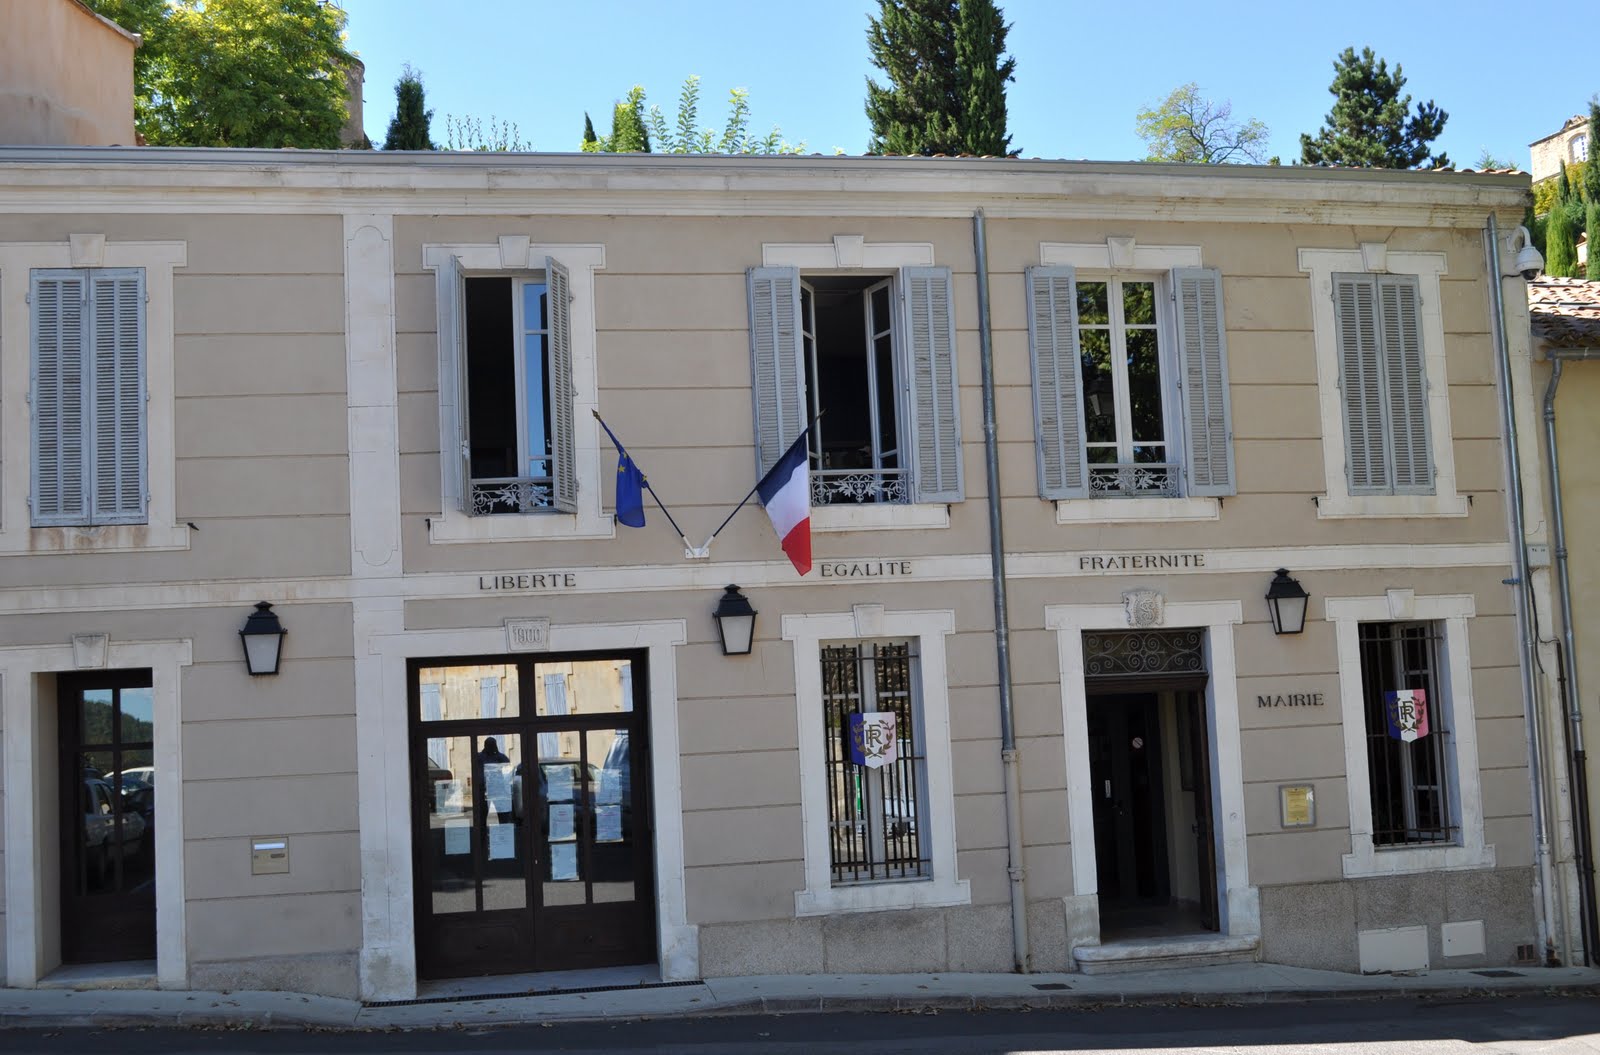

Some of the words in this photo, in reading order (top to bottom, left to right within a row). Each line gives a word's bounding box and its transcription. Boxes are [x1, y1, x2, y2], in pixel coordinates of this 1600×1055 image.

[820, 561, 912, 577] EGALITE
[1079, 554, 1205, 570] FRATERNITE
[479, 573, 576, 590] LIBERTE
[1257, 693, 1324, 708] MAIRIE
